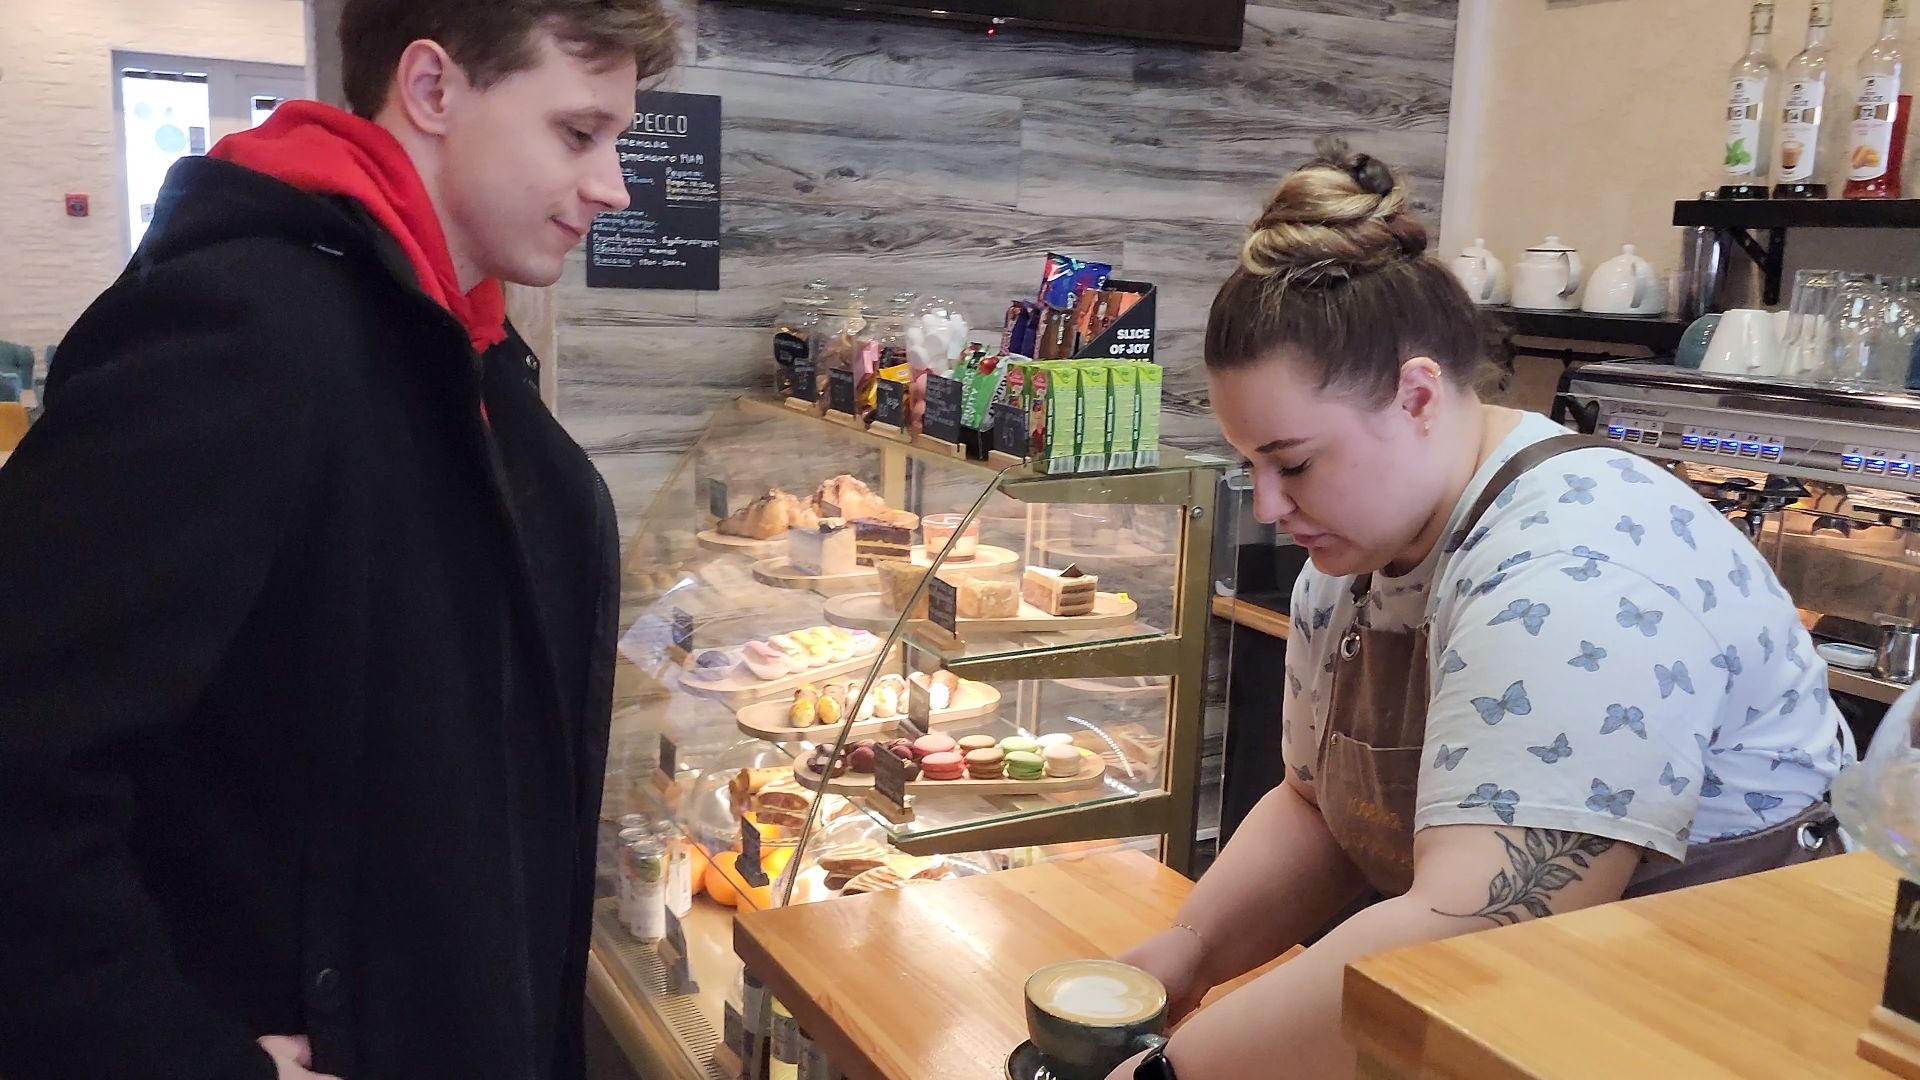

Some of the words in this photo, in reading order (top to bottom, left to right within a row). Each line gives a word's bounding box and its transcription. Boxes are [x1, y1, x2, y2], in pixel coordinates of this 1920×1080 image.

[632, 112, 688, 134] РЕССО
[1117, 328, 1150, 340] SLICE
[1109, 344, 1125, 355] OF
[1126, 343, 1150, 354] JOY
